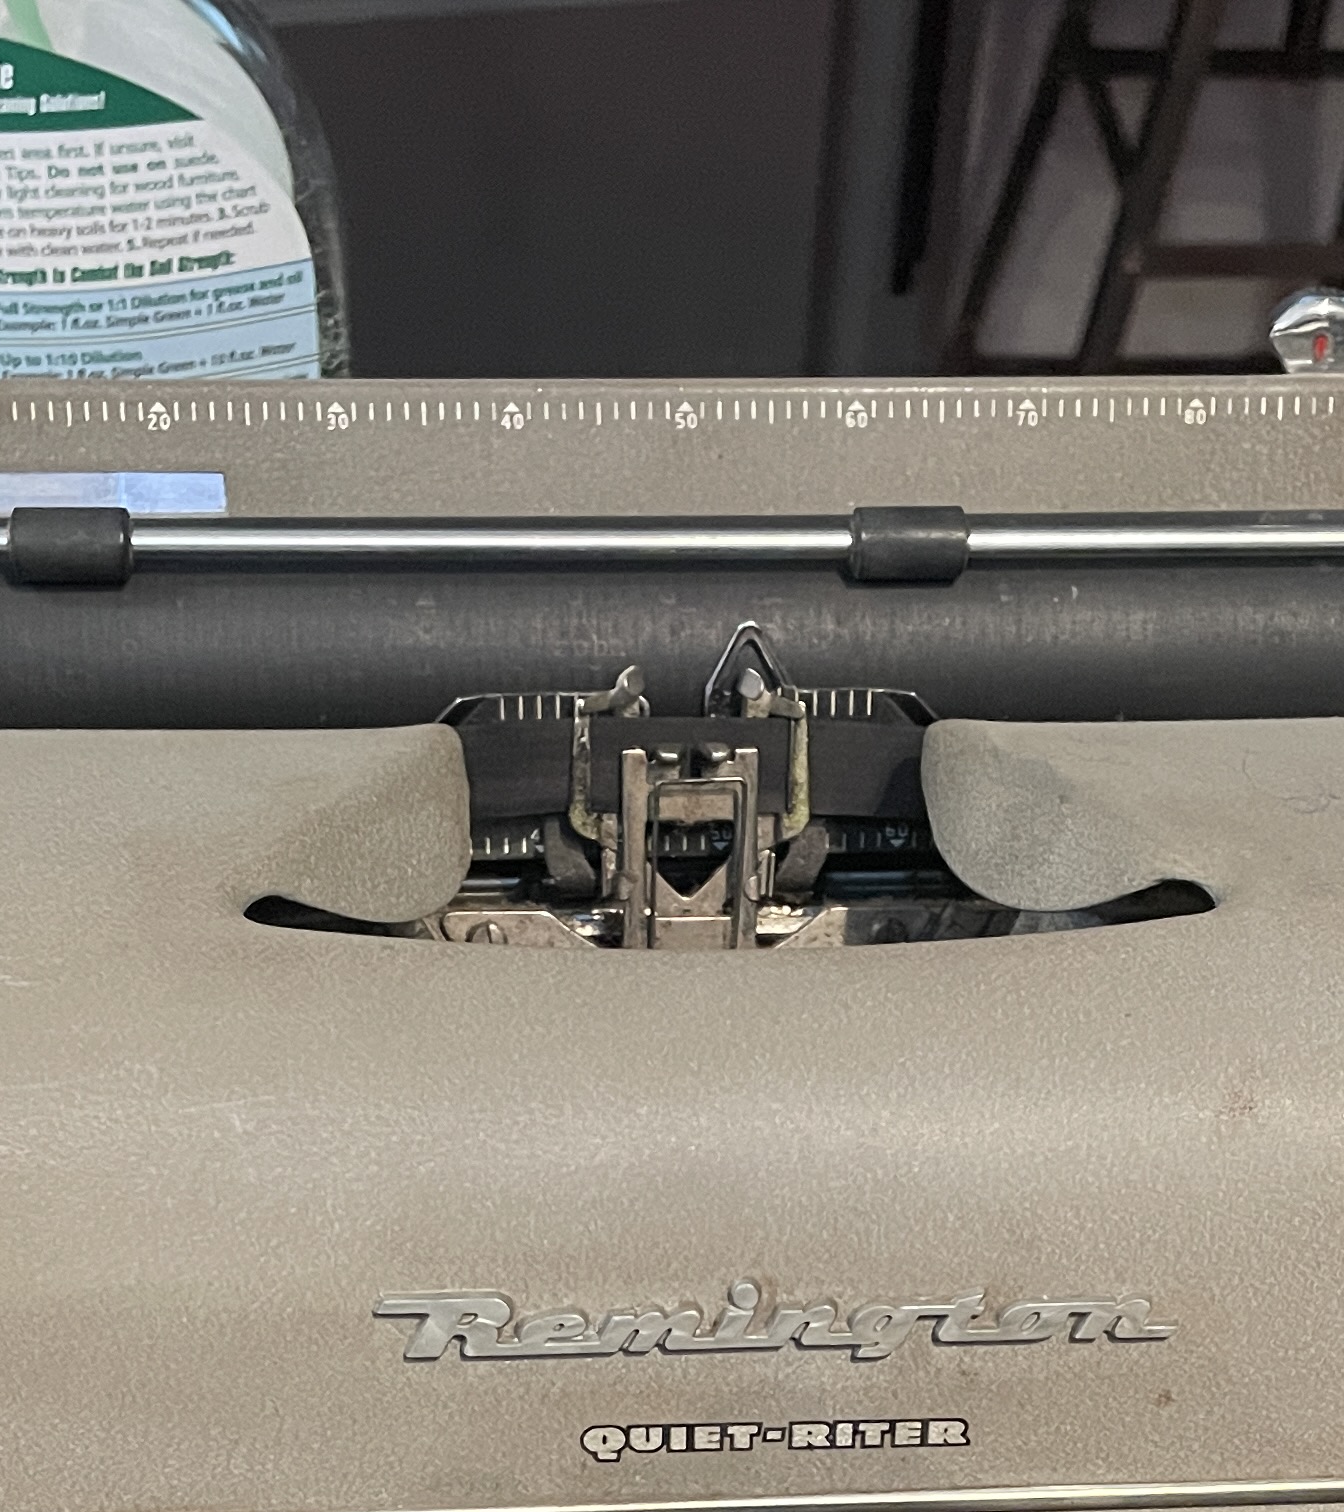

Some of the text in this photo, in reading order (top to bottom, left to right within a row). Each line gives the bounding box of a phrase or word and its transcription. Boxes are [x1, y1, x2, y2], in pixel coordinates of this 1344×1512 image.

[47, 165, 70, 180] Do
[146, 159, 167, 172] on
[147, 410, 171, 431] 20
[326, 410, 350, 432] 30
[500, 411, 525, 431] 40
[674, 411, 699, 430] 50
[844, 410, 869, 430] 60
[1015, 408, 1040, 427] 70
[1183, 407, 1207, 426] 80
[372, 1276, 1180, 1363] Remington
[580, 1417, 970, 1463] QUIET-RITER
